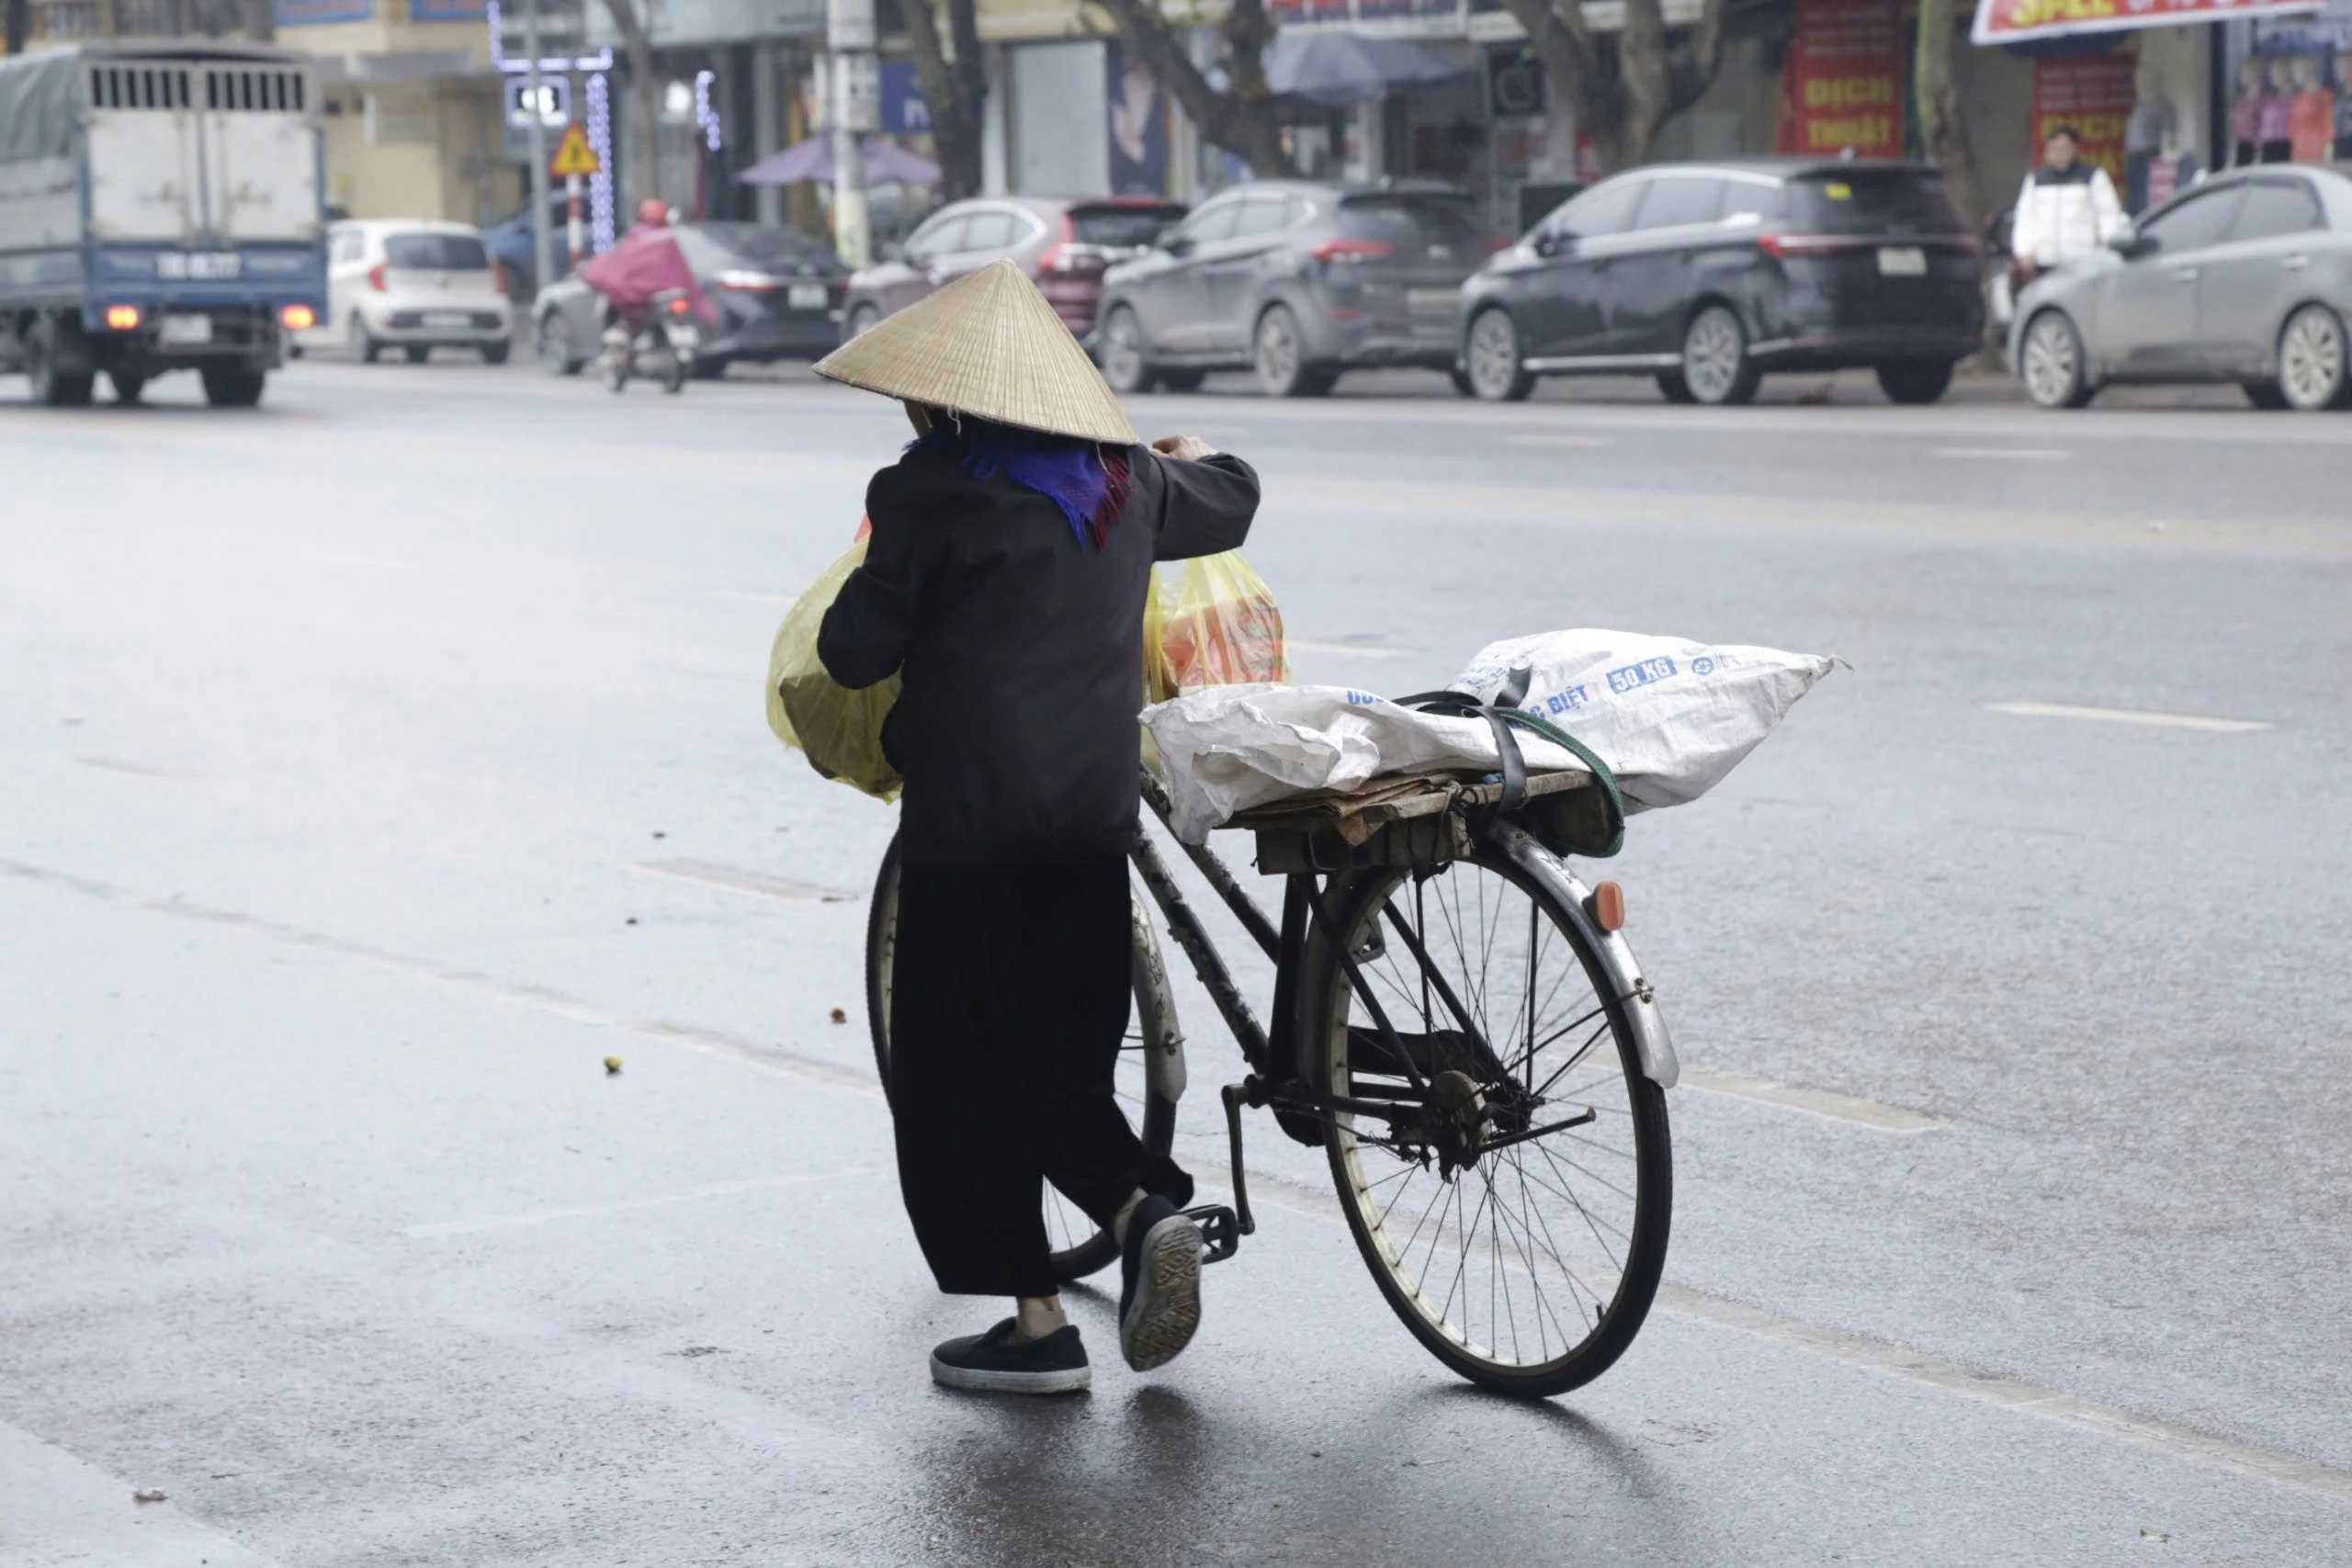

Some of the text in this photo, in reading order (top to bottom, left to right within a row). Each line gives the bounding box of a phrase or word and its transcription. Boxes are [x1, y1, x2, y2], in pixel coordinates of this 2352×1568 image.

[1547, 658, 1672, 716] BIỆT 50 KG
